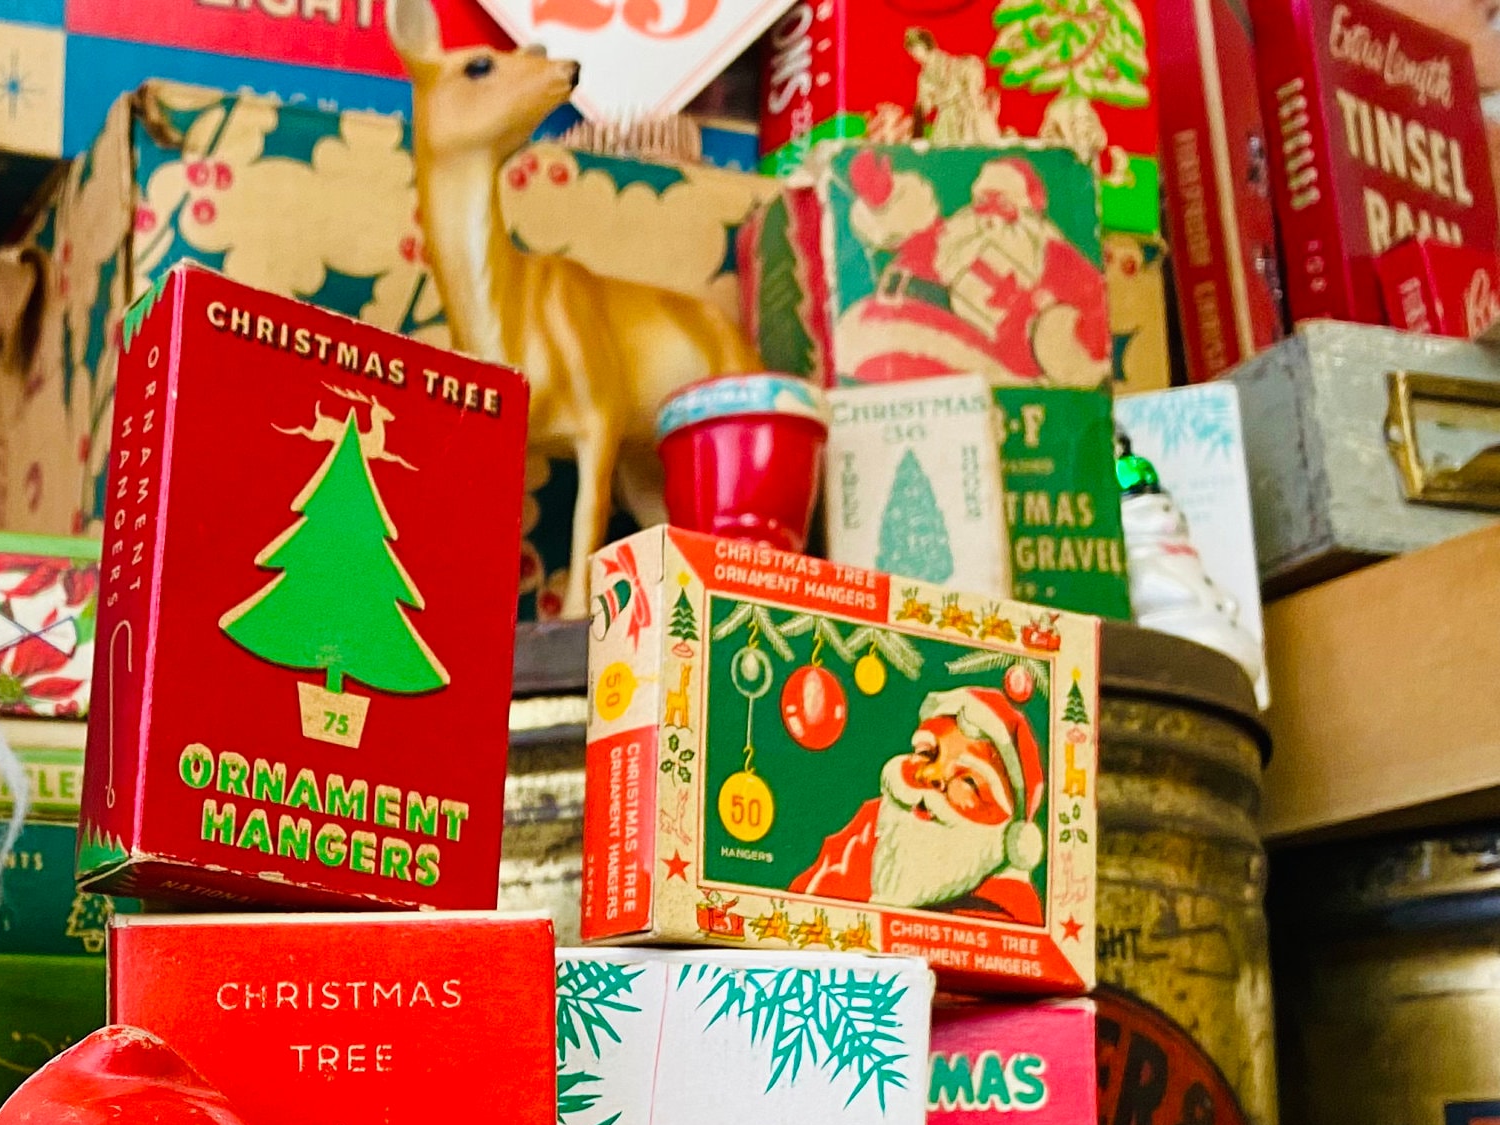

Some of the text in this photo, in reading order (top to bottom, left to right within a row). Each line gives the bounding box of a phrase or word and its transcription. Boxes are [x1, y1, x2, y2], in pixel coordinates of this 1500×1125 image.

[1336, 88, 1474, 206] TINSEL
[205, 300, 502, 417] CHRISTMAS TREE
[129, 345, 160, 591] ORNAMENT
[106, 415, 133, 608] HANGERS
[714, 540, 877, 590] CHRISTMAS TREE
[1014, 535, 1123, 574] GRAVEL
[714, 565, 878, 611] ORNAMENT HANGERS
[605, 670, 622, 709] 50
[323, 711, 349, 736] 75
[179, 742, 470, 842] ORNAMENT
[731, 794, 761, 828] 50
[201, 798, 441, 887] HANGERS
[606, 747, 622, 921] ORNAMENT HANGERS
[623, 742, 640, 913] CHRISTMAS TREE
[721, 845, 774, 864] HANGERS
[890, 920, 1039, 955] CHRISTMAS TREE
[974, 953, 1043, 978] HANGERS
[216, 978, 463, 1011] CHRISTMAS
[289, 1043, 394, 1073] TREE
